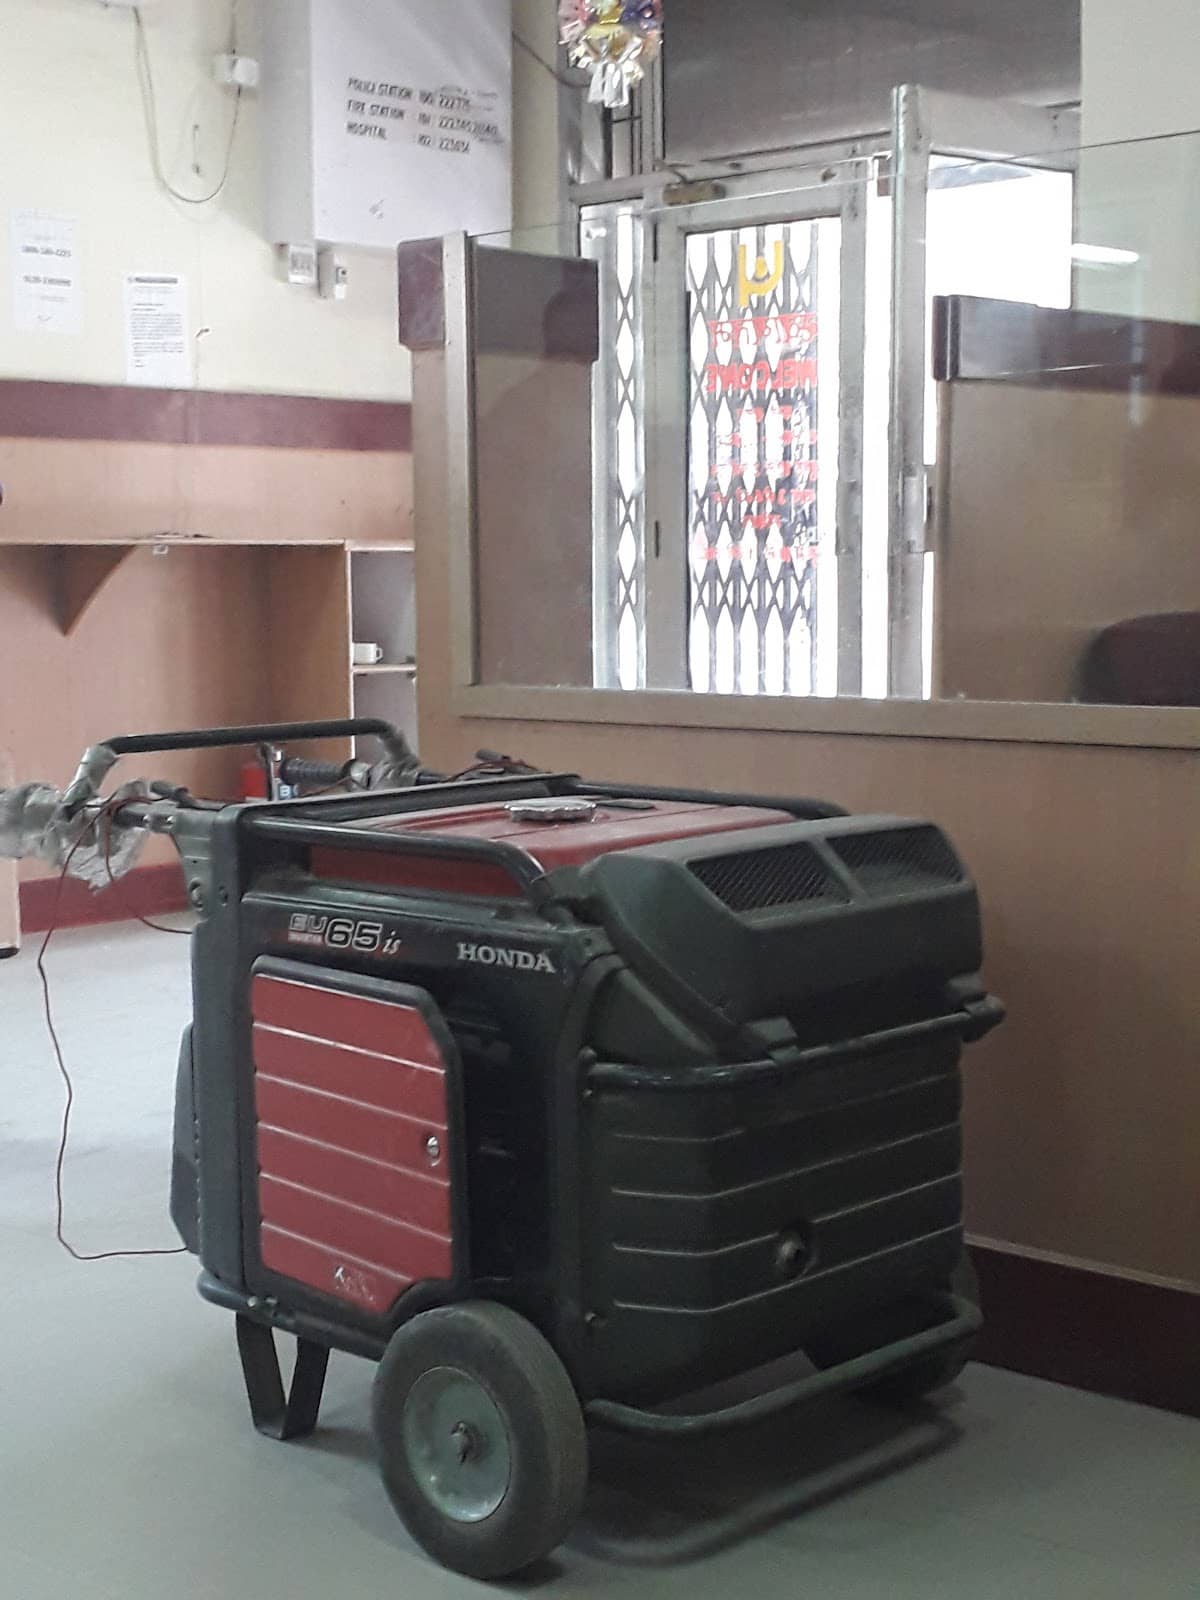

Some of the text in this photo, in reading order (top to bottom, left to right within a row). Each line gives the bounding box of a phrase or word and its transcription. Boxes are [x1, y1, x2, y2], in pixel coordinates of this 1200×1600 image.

[377, 83, 413, 101] STATION
[368, 104, 405, 121] STATION
[347, 121, 387, 140] HOSPITAL
[456, 941, 557, 974] HONDA
